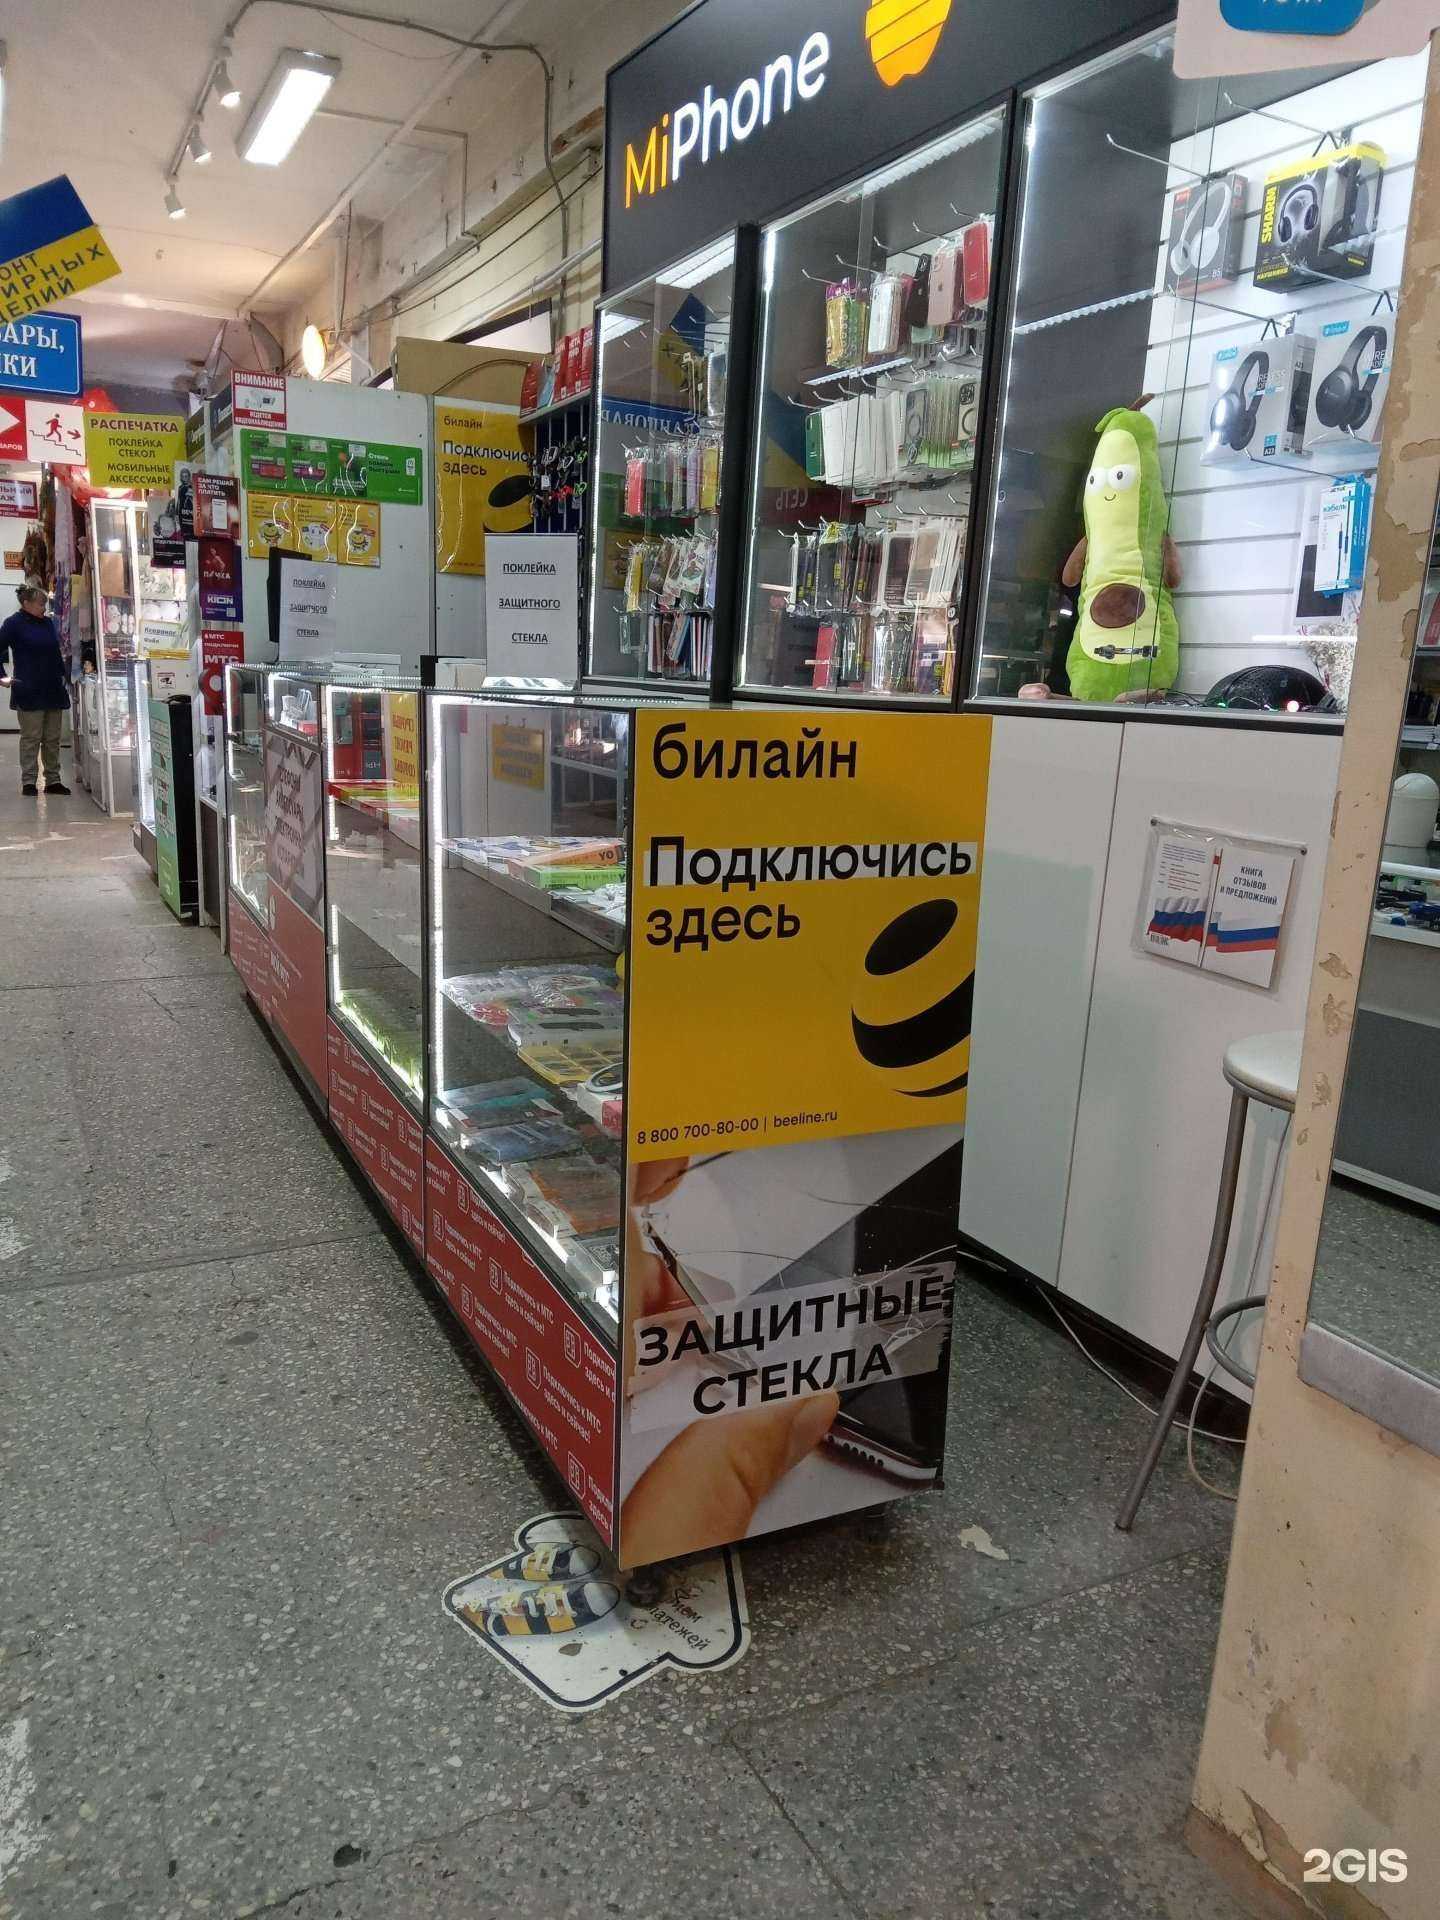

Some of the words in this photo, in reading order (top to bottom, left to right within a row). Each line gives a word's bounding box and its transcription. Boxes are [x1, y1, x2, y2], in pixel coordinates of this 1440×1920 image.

[625, 31, 830, 209] MiPhone
[0, 353, 37, 378] КИ
[234, 373, 285, 389] ВНИМАНИЕ
[90, 418, 179, 433] РАСПЕЧАТКА
[444, 415, 482, 429] билайн
[109, 438, 163, 448] ПОКЛЕЙКА
[119, 449, 156, 459] СТЕКОЛ
[443, 440, 532, 464] Подключис
[107, 463, 170, 473] МОБИЛЬНЫЕ
[443, 462, 487, 477] здесь
[109, 475, 171, 485] АКСЕССУАРЫ
[503, 562, 556, 573] ПОКЛЕЙКА
[293, 578, 326, 589] ПОКЛЕЙКА
[289, 603, 328, 613] ЗАЩИТНОГО
[499, 598, 560, 609] ЗАЩИТНОГО
[296, 628, 319, 637] СТЕКЛА
[511, 632, 548, 642] СТЕКЛА
[204, 655, 239, 664] МТС
[652, 722, 857, 779] билайн
[649, 836, 972, 892] Подключись
[1240, 866, 1263, 878] КНИГА
[1233, 876, 1267, 890] ОТЗЫВОВ
[1225, 887, 1278, 905] ПРЕДЛОЖЕНИЙ
[645, 903, 801, 953] здесь
[773, 1111, 838, 1128] beeline.ru
[637, 1131, 646, 1144] 8
[650, 1127, 678, 1143] 800
[683, 1118, 759, 1139] 700-80-00
[638, 1275, 944, 1366] ЗАЩИТНЫЕ
[693, 1344, 893, 1415] СТЕКЛА
[586, 1407, 602, 1434] МТС
[648, 1607, 712, 1651] латежей
